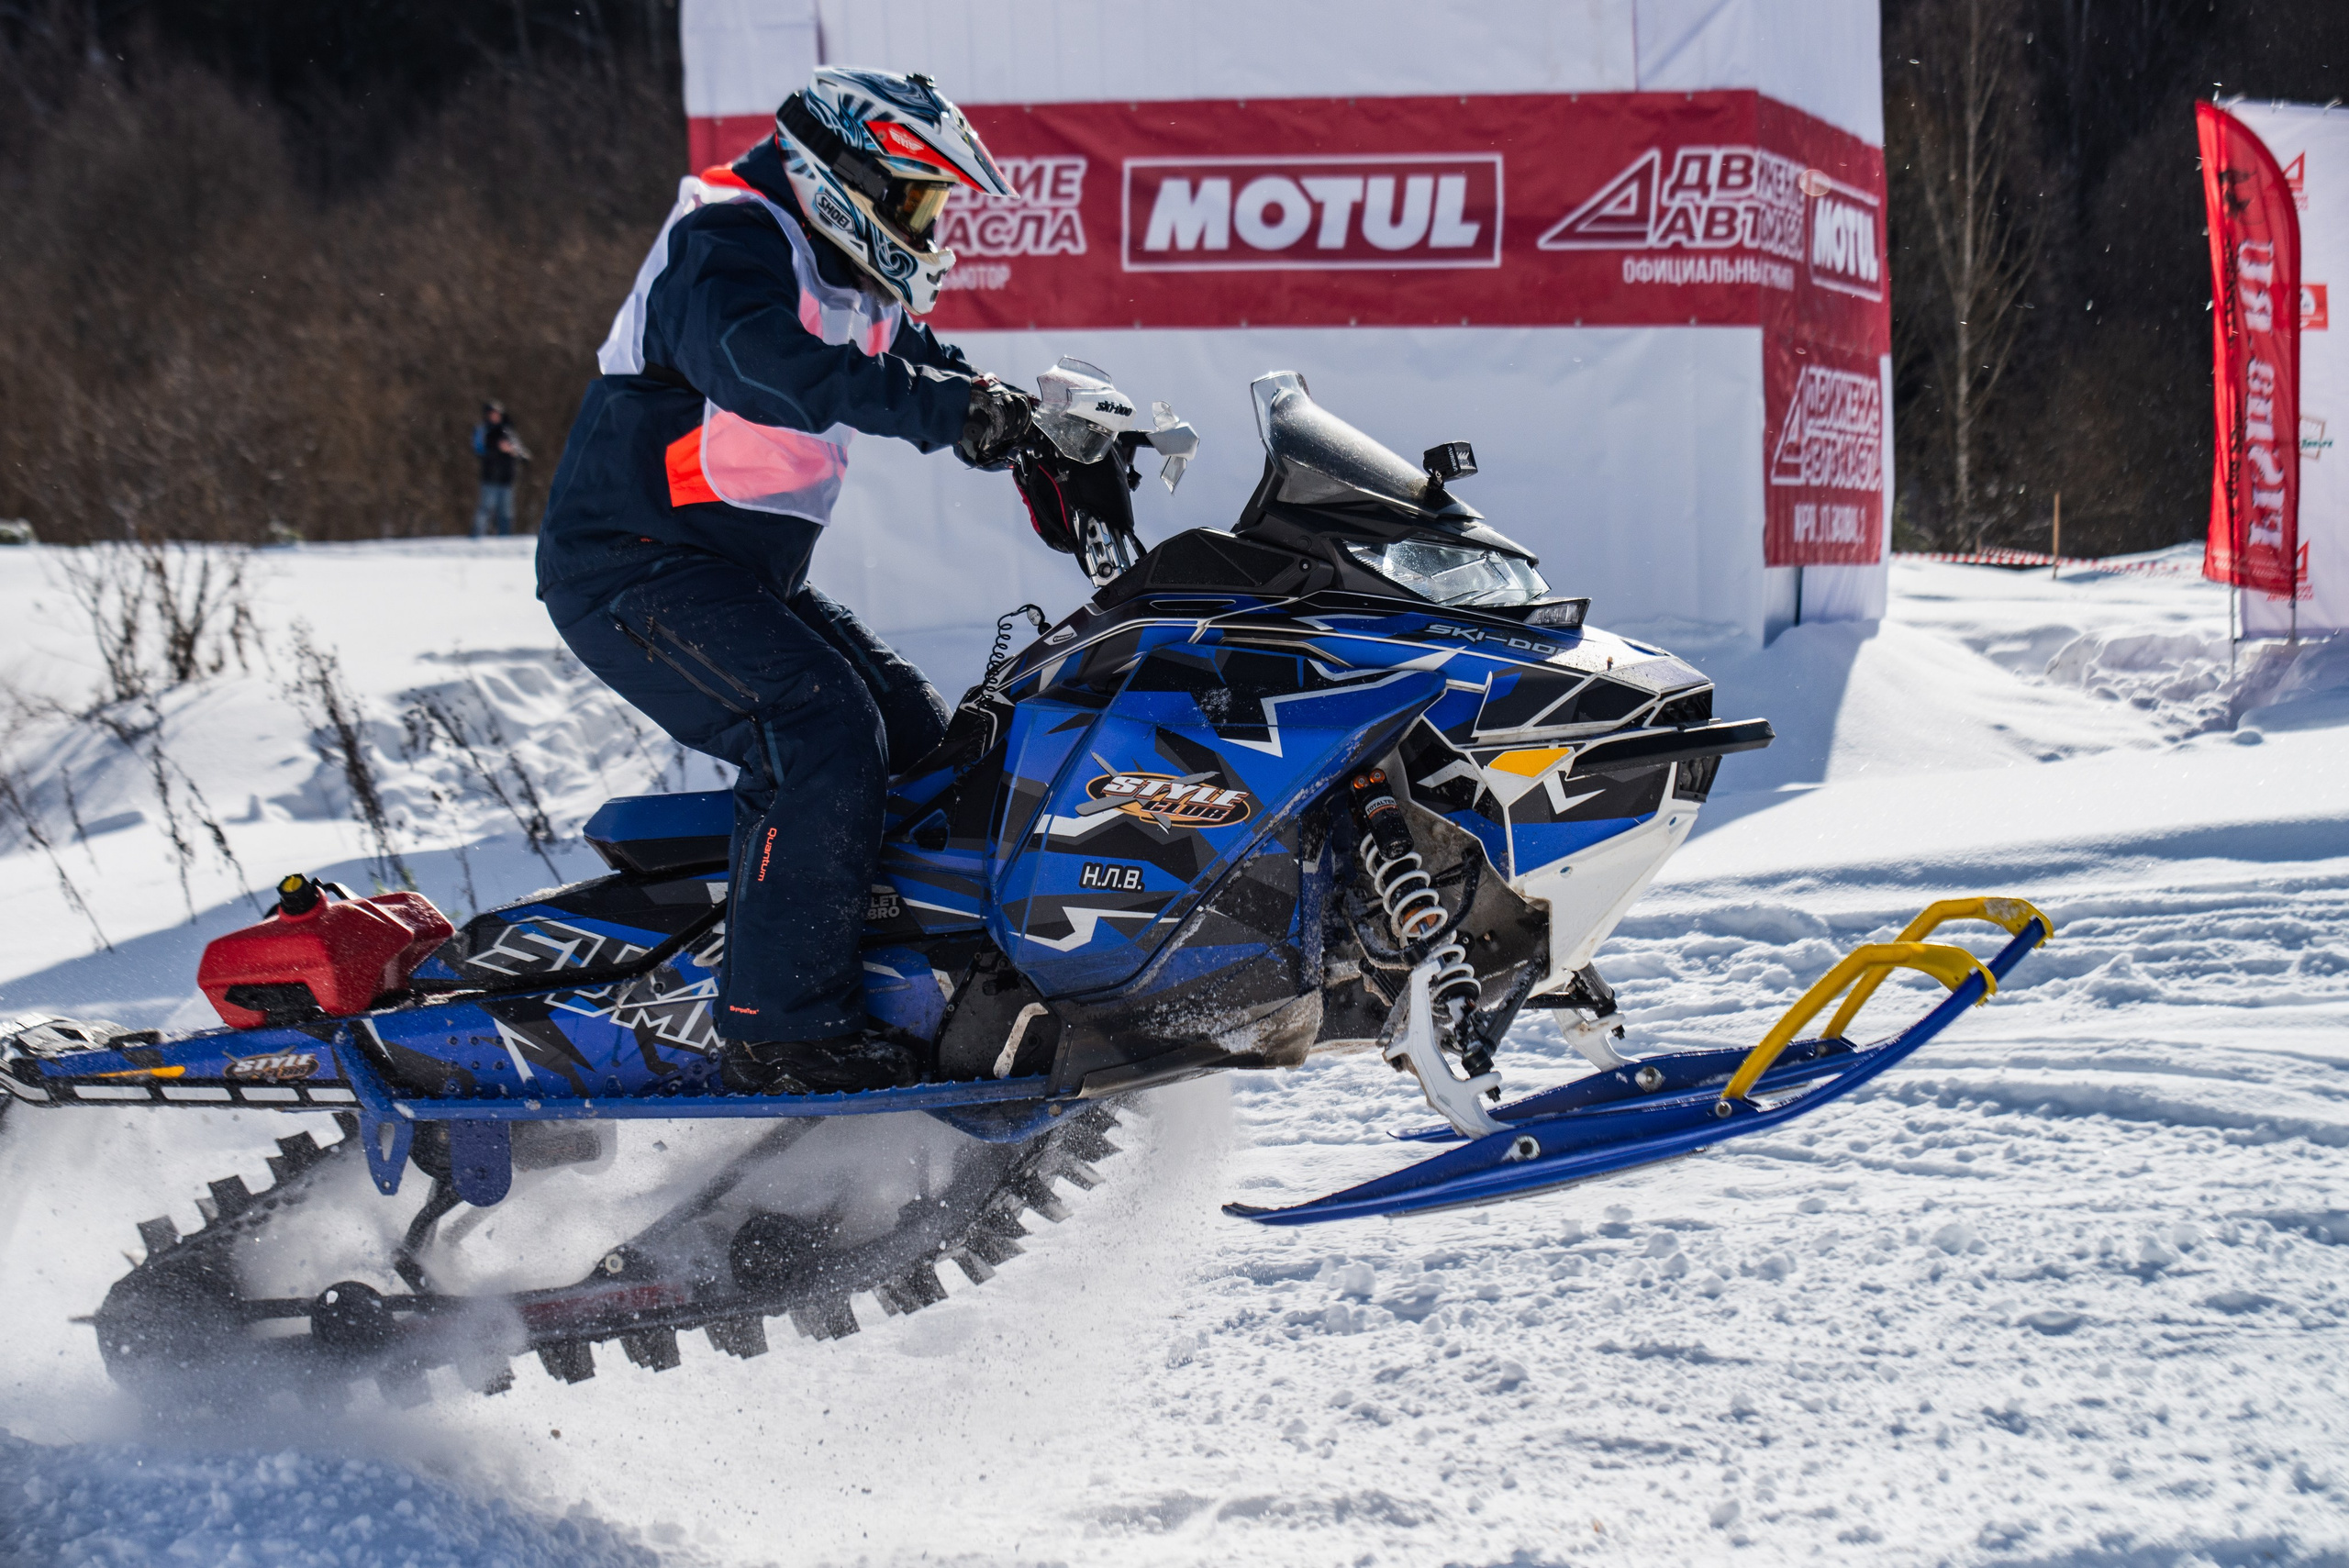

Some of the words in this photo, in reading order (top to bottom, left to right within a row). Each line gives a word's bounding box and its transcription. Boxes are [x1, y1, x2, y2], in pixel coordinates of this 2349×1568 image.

[937, 209, 1086, 256] АСЛА
[1143, 174, 1480, 251] MOTUL
[1812, 196, 1879, 283] MOTUL
[1141, 800, 1230, 822] CLUB
[758, 828, 777, 882] Quantum
[1083, 865, 1142, 891] Н.Л.В.
